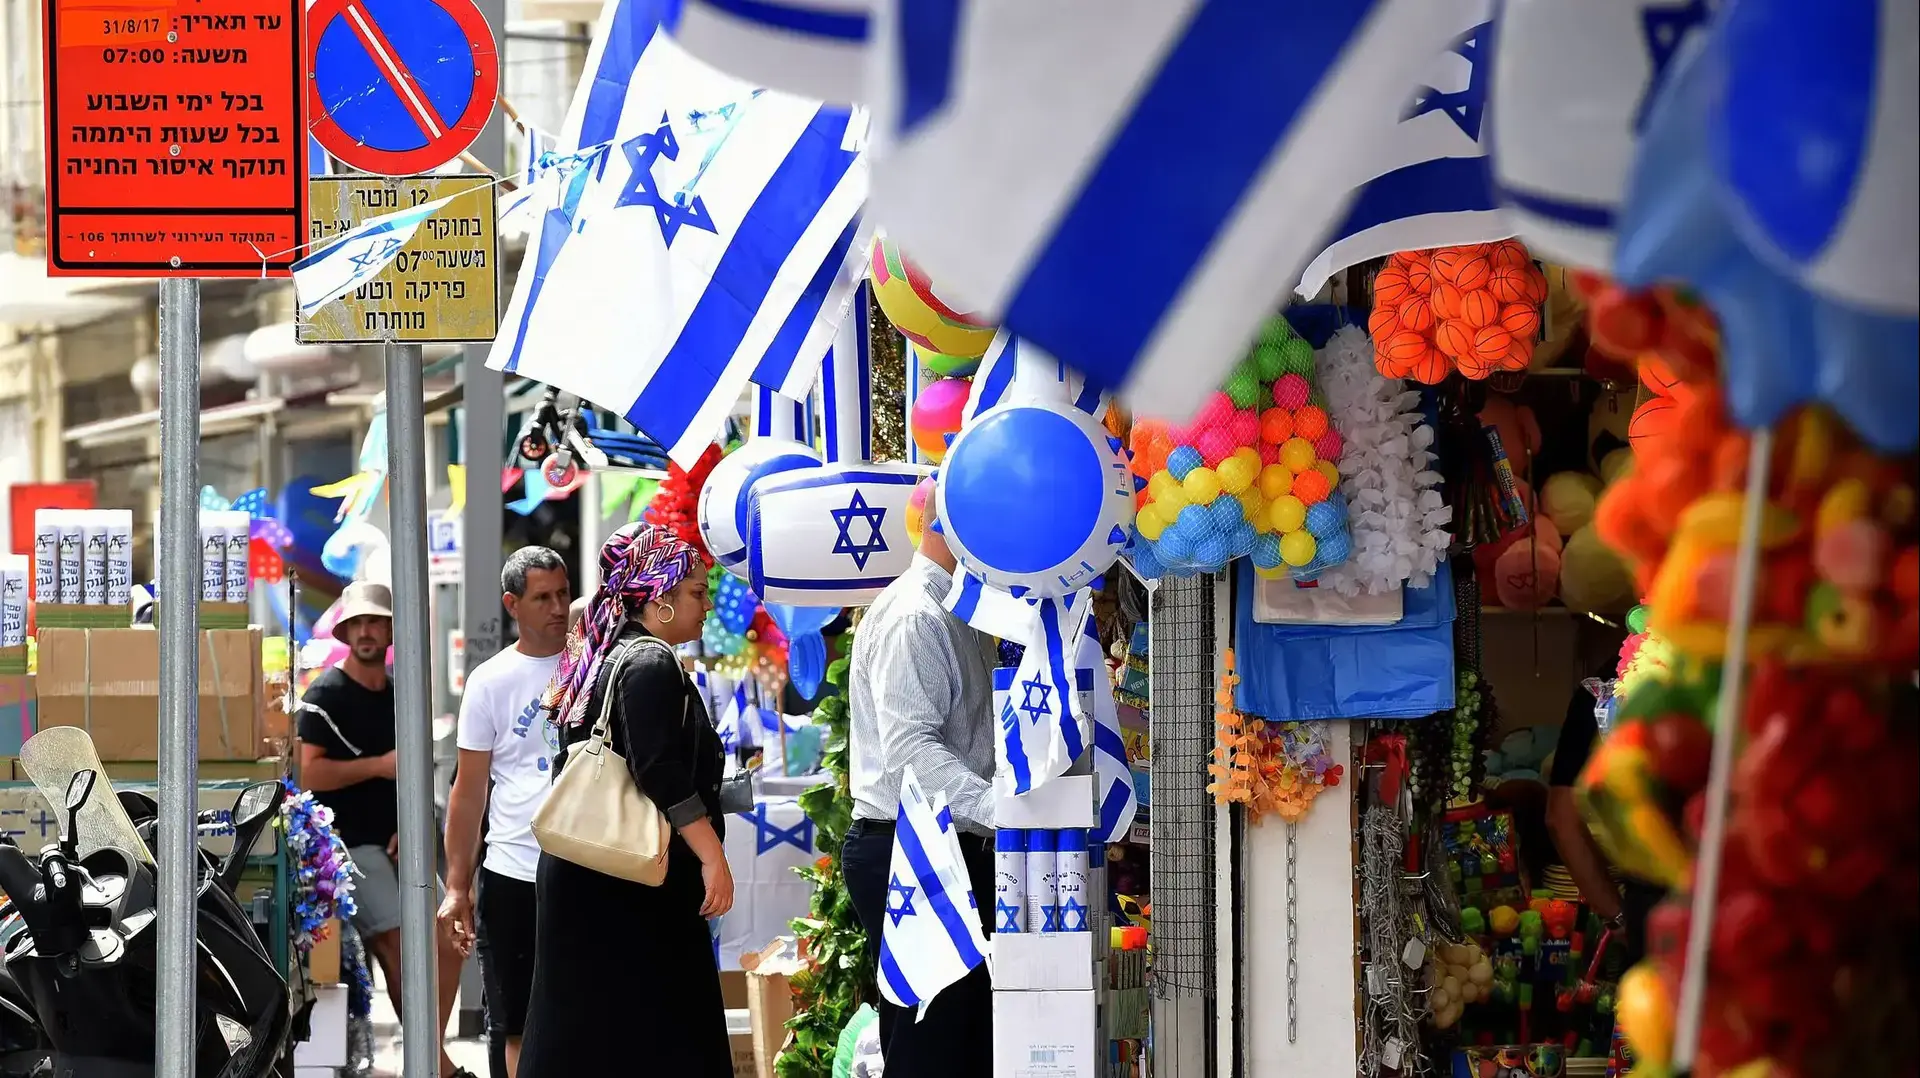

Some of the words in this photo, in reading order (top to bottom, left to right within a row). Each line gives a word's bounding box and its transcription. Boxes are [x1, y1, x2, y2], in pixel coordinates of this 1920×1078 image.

[103, 19, 160, 35] 31/8/17
[171, 15, 246, 33] תאריך:
[254, 15, 281, 30] עד
[103, 49, 165, 64] 07:00
[173, 49, 247, 64] משעה:
[87, 95, 168, 111] השבוע
[176, 95, 213, 111] ימי
[221, 91, 264, 111] בכל
[72, 126, 152, 143] היממה
[160, 127, 229, 143] שעות
[237, 124, 280, 143] בכל
[67, 158, 137, 175] החניה
[146, 158, 214, 175] איסור
[222, 158, 286, 178] תוקף
[356, 188, 398, 208] מטר
[410, 188, 429, 206] 12
[79, 232, 104, 242] 106
[111, 231, 166, 242] לשרותך
[172, 232, 224, 242] העירוני
[427, 218, 482, 240] בתוקף
[230, 232, 275, 245] המוקד
[436, 250, 486, 268] משעה
[405, 281, 465, 302] פריקה
[365, 311, 425, 330] מותרת
[1130, 678, 1145, 691] NEW
